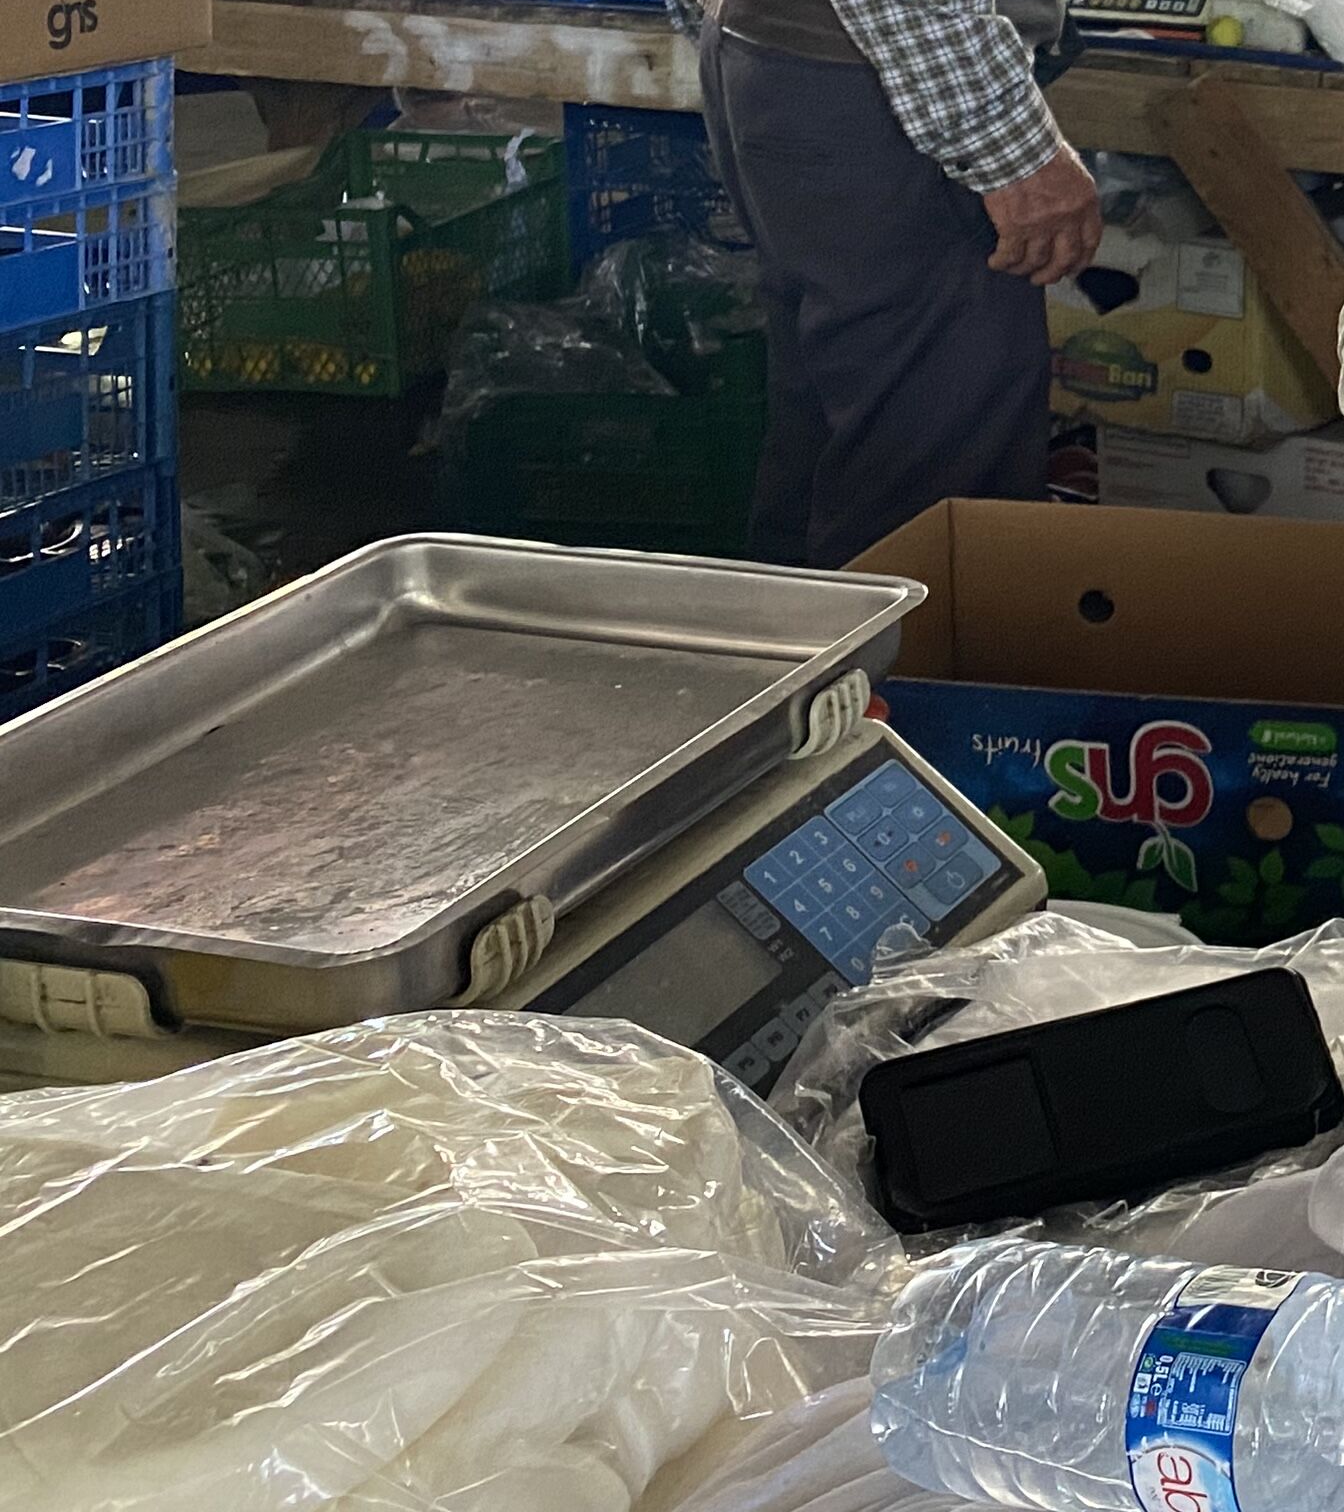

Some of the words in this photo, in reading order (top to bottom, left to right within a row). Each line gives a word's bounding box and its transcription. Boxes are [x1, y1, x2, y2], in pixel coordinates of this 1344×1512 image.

[971, 731, 1043, 767] fruits
[764, 870, 778, 885] 1
[790, 850, 805, 865] 2
[814, 830, 829, 846] 3
[842, 858, 857, 873] 6
[819, 927, 834, 942] 7
[846, 905, 860, 920] 8
[870, 885, 885, 900] 9
[1152, 1354, 1174, 1382] 0,5L
